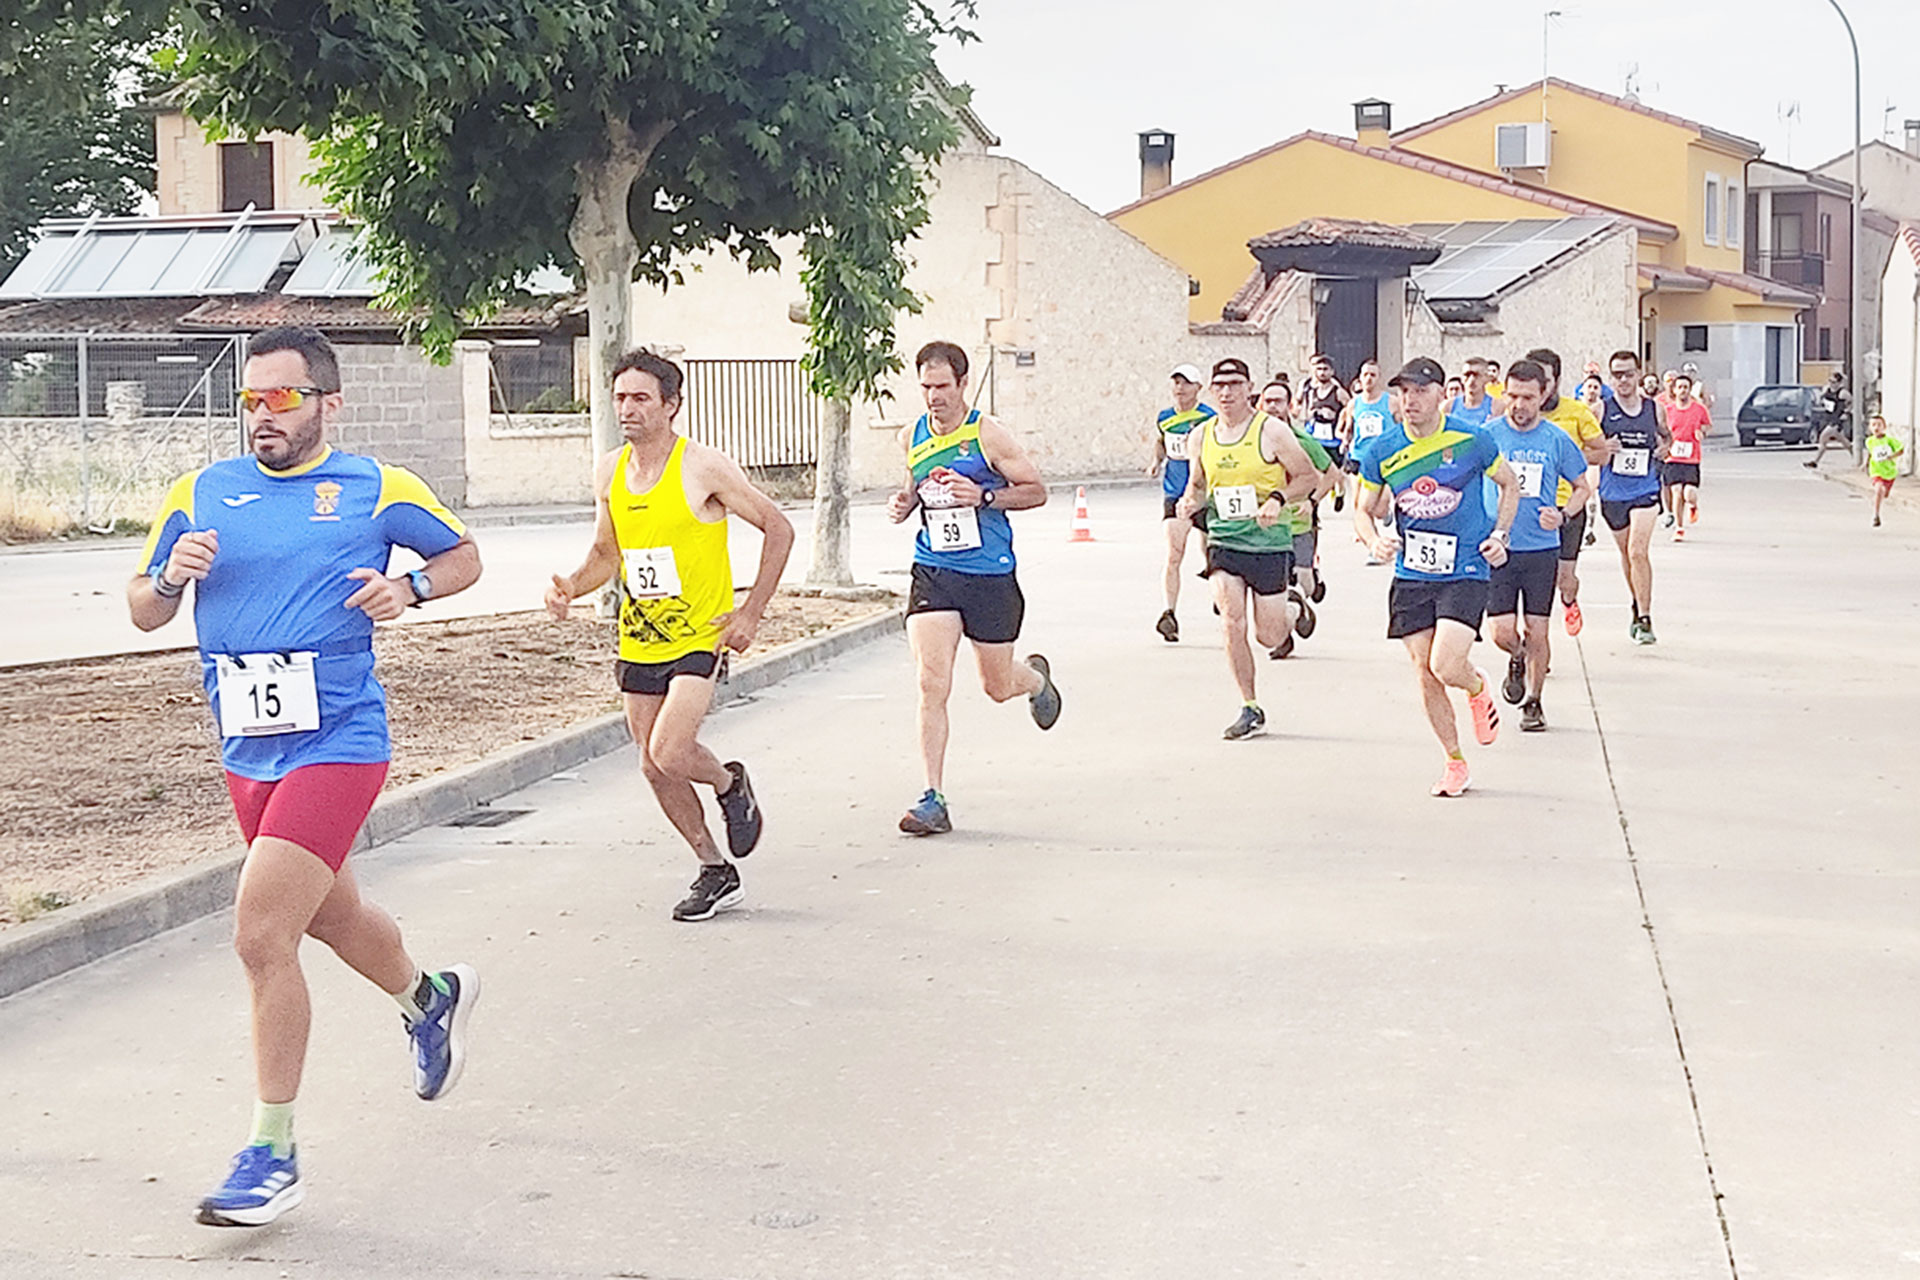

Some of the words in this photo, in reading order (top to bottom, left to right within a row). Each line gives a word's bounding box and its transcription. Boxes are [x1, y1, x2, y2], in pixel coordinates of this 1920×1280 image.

[1228, 498, 1242, 514] 57
[943, 523, 961, 542] 59
[1420, 545, 1437, 566] 53
[638, 566, 659, 590] 52
[249, 683, 281, 719] 15
